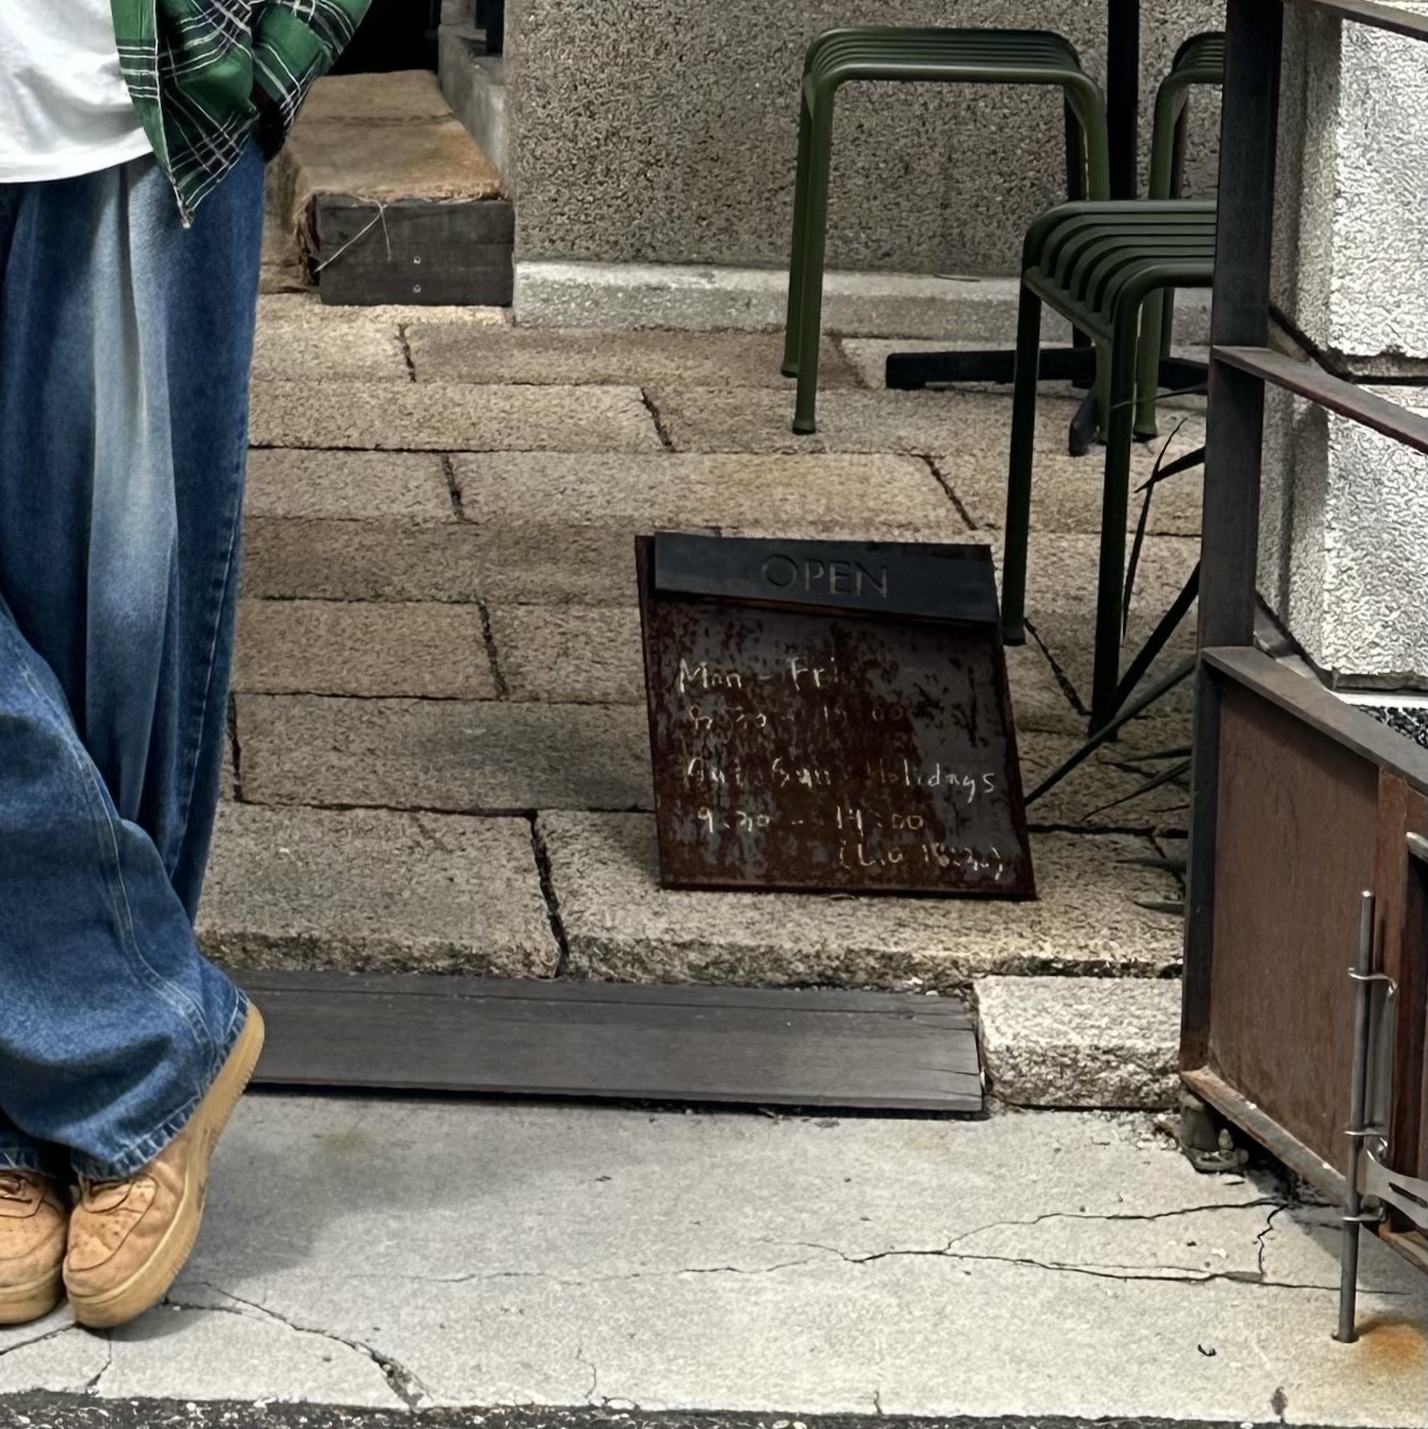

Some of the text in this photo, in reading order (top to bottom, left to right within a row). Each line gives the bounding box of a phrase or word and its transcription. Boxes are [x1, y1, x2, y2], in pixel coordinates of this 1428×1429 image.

[762, 554, 889, 598] OPEN
[679, 657, 742, 693] Mon
[787, 656, 839, 691] Fri
